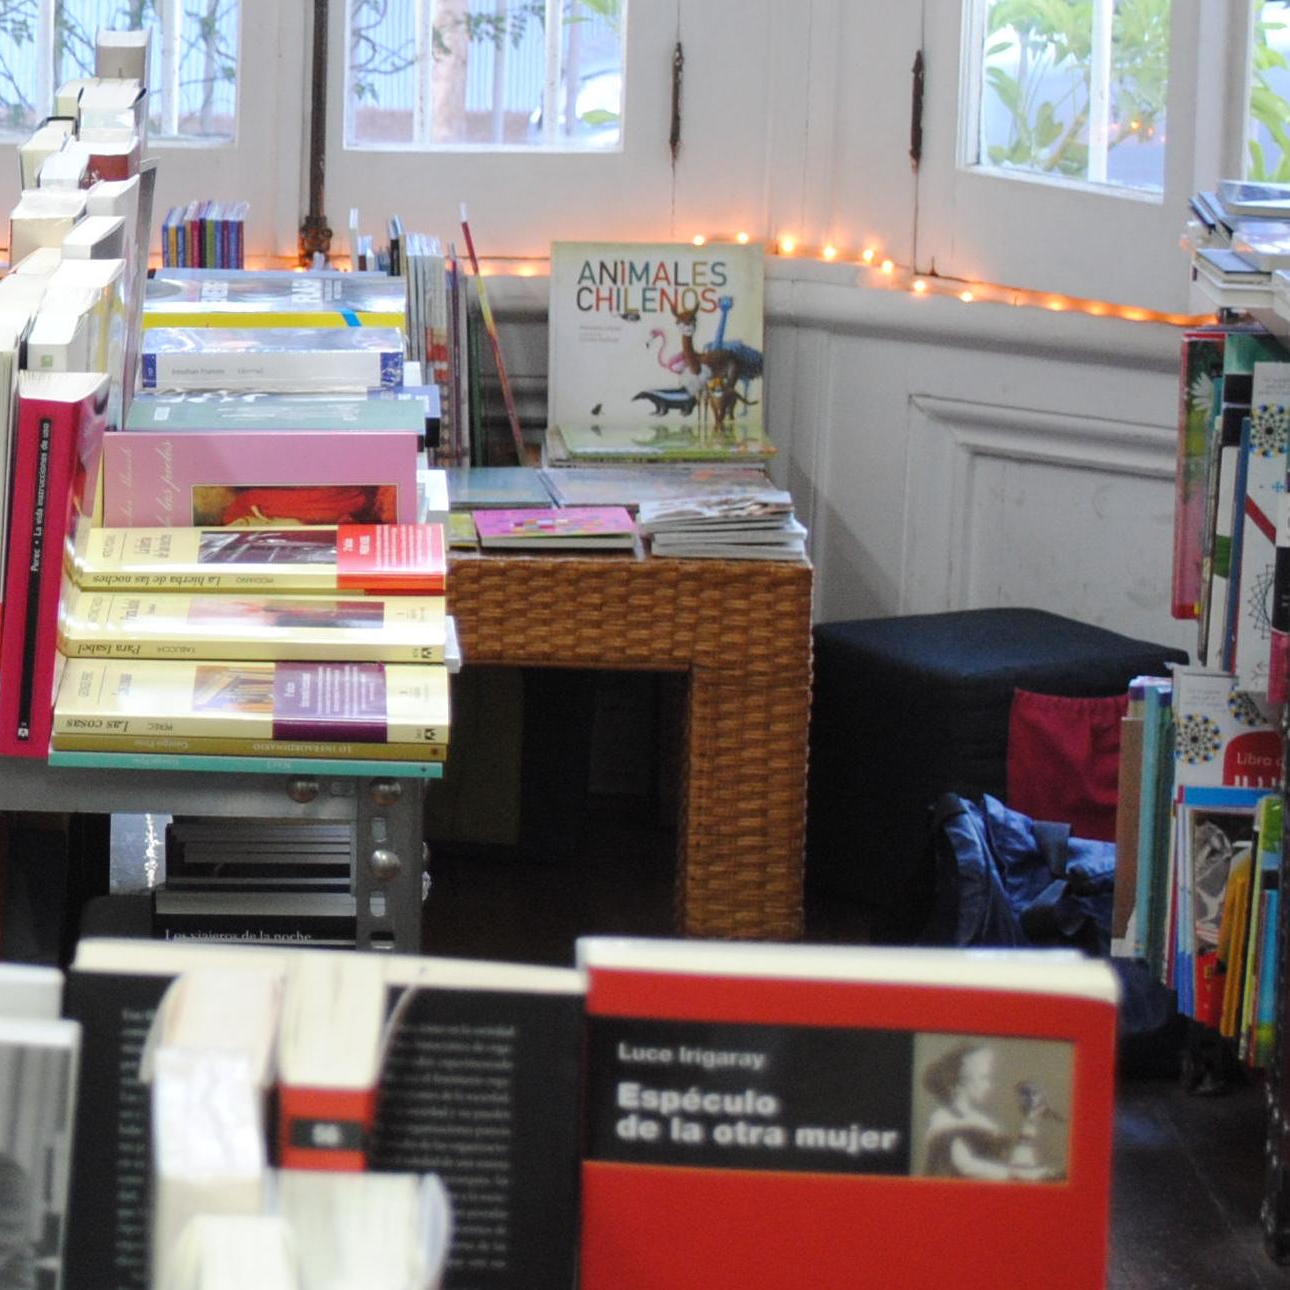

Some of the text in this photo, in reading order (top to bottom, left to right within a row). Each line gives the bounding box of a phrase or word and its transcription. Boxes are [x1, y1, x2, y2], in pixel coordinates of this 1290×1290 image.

[576, 259, 729, 287] ANIMALES
[576, 286, 719, 314] CHILENOS
[31, 422, 51, 572] Perec La vida instrucciones de uso
[92, 573, 132, 586] noches
[134, 574, 151, 586] las
[152, 574, 167, 586] de
[169, 574, 206, 586] hierba
[207, 574, 221, 586] La
[76, 643, 112, 655] Isabel
[115, 643, 142, 654] Para
[65, 718, 174, 732] PEREC Las cosas
[165, 929, 313, 943] Los viajeros de la noche
[618, 1042, 768, 1071] Luce Irigaray
[617, 1081, 781, 1116] Espéculo
[615, 1114, 900, 1155] de la otra mujer
